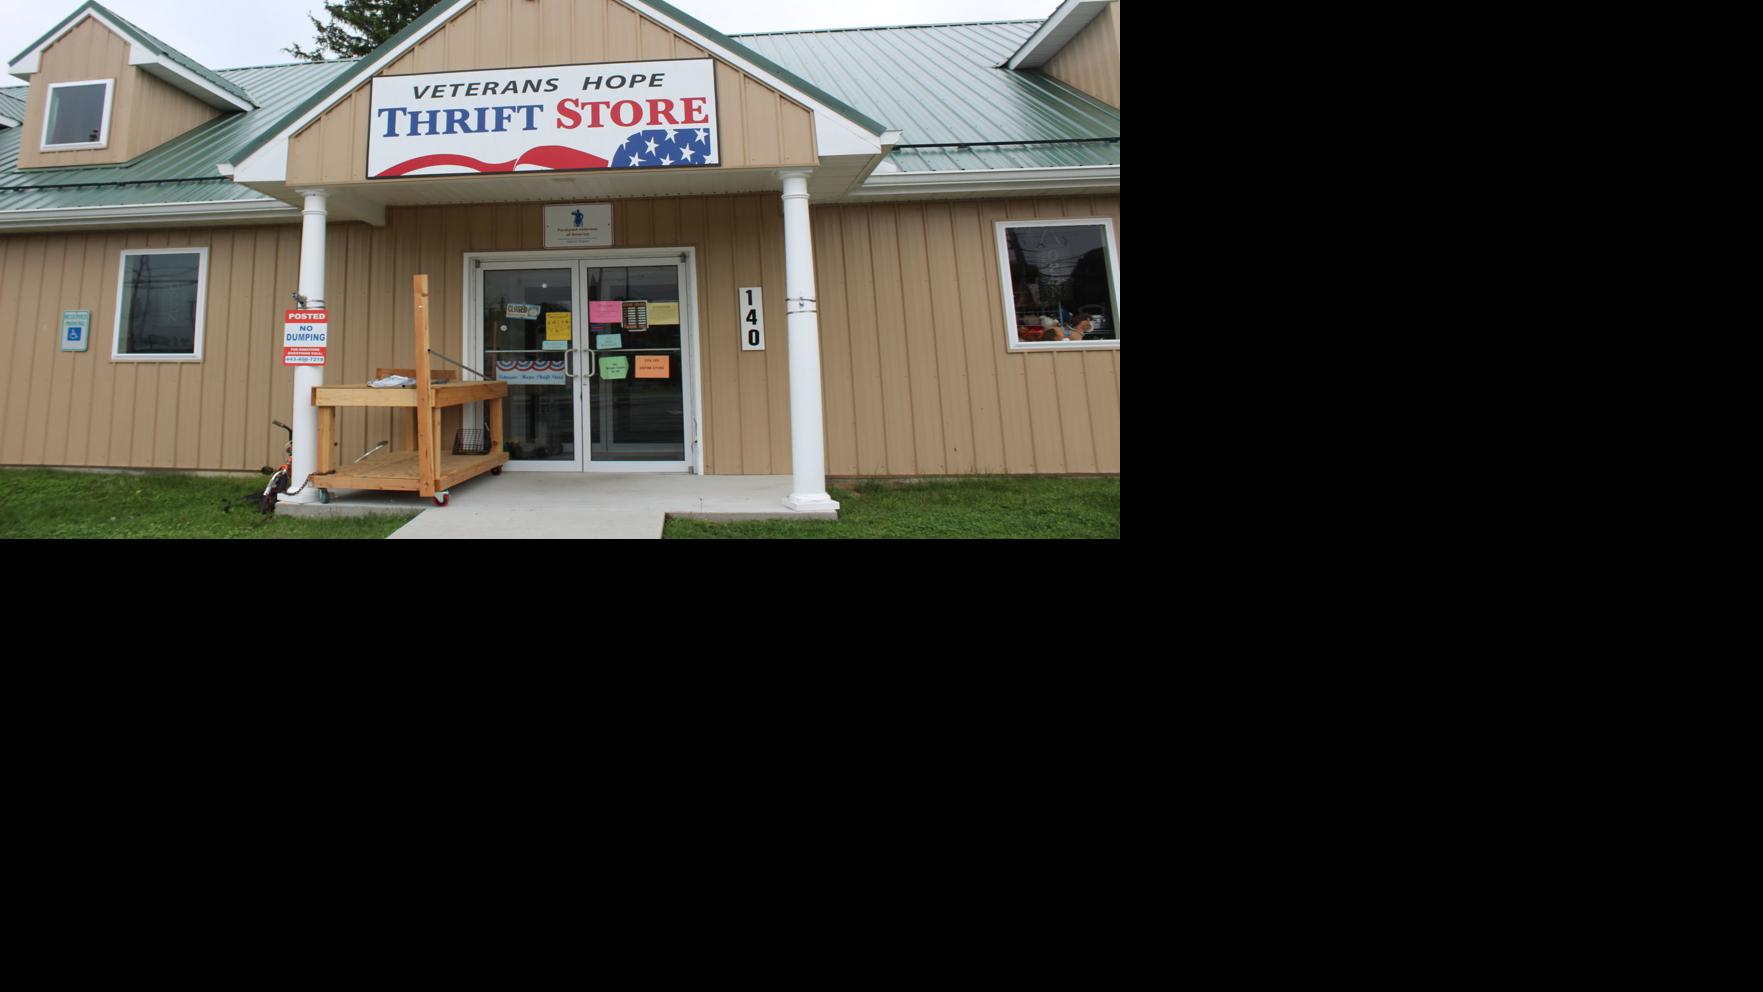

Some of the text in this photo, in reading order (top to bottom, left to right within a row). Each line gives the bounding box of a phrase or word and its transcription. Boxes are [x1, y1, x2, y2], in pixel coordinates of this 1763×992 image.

[413, 73, 665, 99] VETERANS HOPE
[378, 97, 709, 138] THRIFT STORE
[745, 289, 760, 346] 140
[286, 333, 326, 341] DUMPING
